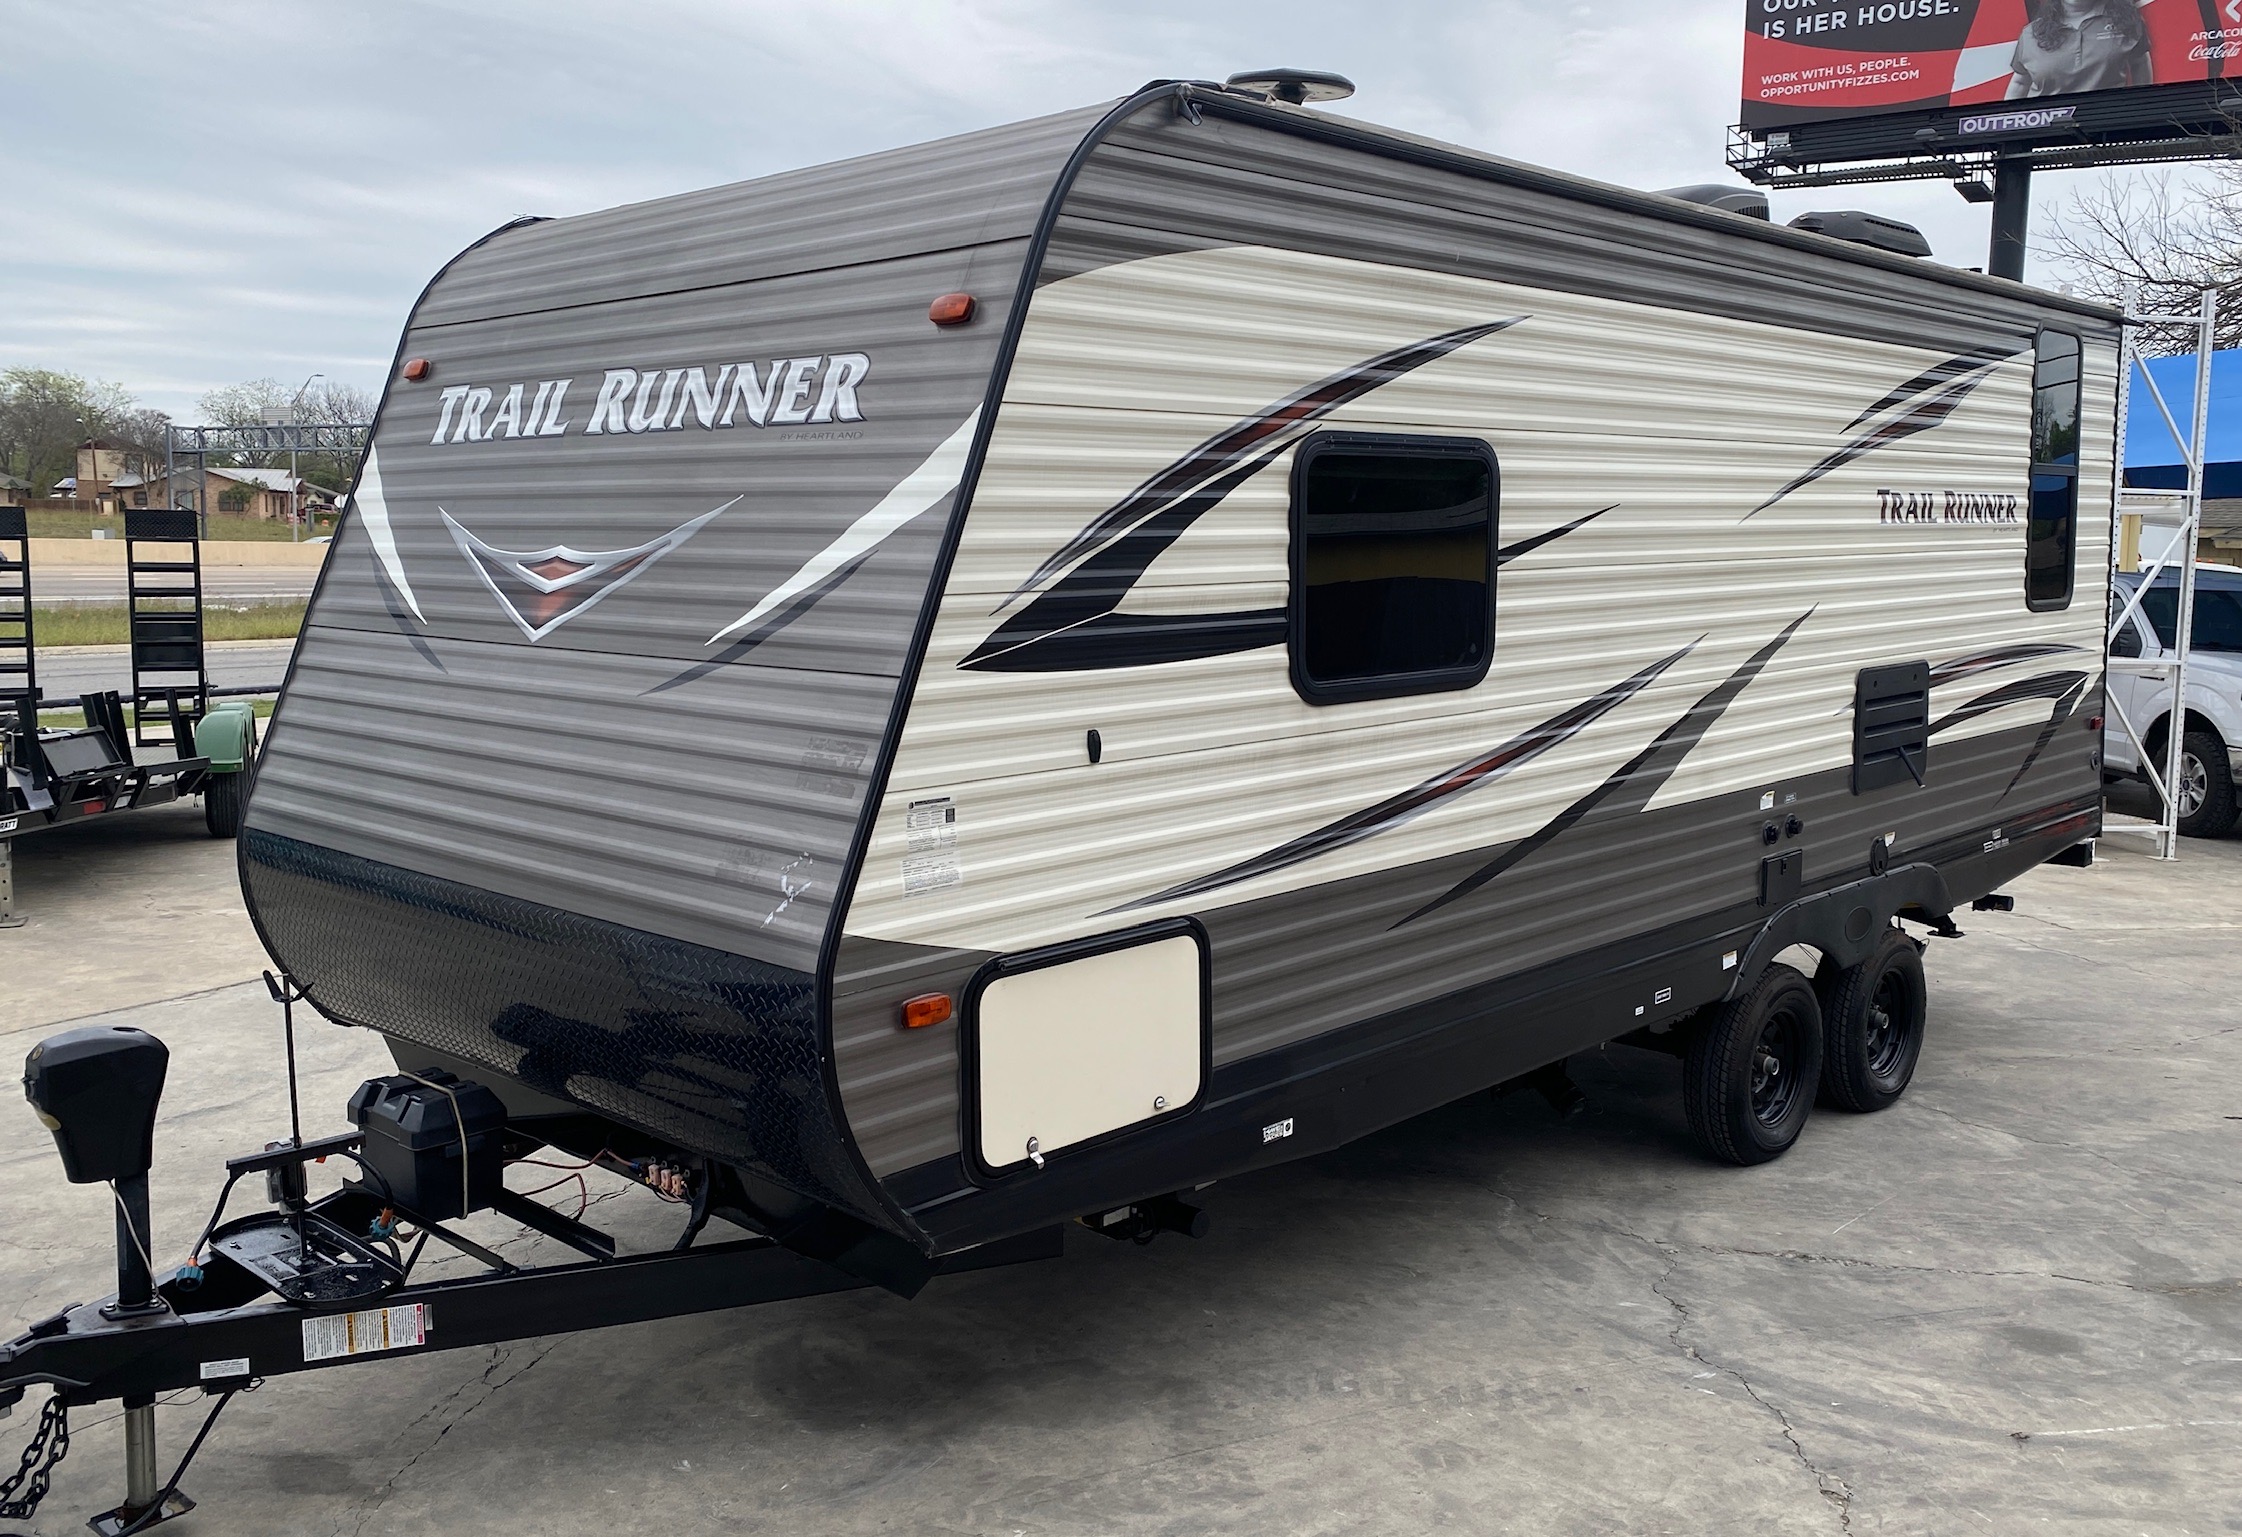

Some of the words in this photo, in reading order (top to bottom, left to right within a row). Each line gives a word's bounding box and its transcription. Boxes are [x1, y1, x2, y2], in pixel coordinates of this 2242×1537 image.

[1763, 20, 1786, 40] IS
[1796, 11, 1847, 36] HER
[1858, 0, 1959, 26] HOUSE.
[1760, 69, 1920, 98] OPPORTUNITYFIZZES.COM
[1761, 72, 1798, 85] WORK
[1801, 67, 1834, 81] WITH
[1837, 64, 1856, 76] US,
[1860, 57, 1911, 73] PEOPLE.
[430, 377, 575, 446] TRAIL
[582, 351, 868, 436] RUNNER
[796, 430, 864, 441] HEARTLAND
[1877, 488, 1938, 525] TRAIL
[1943, 490, 2018, 525] RUNNER
